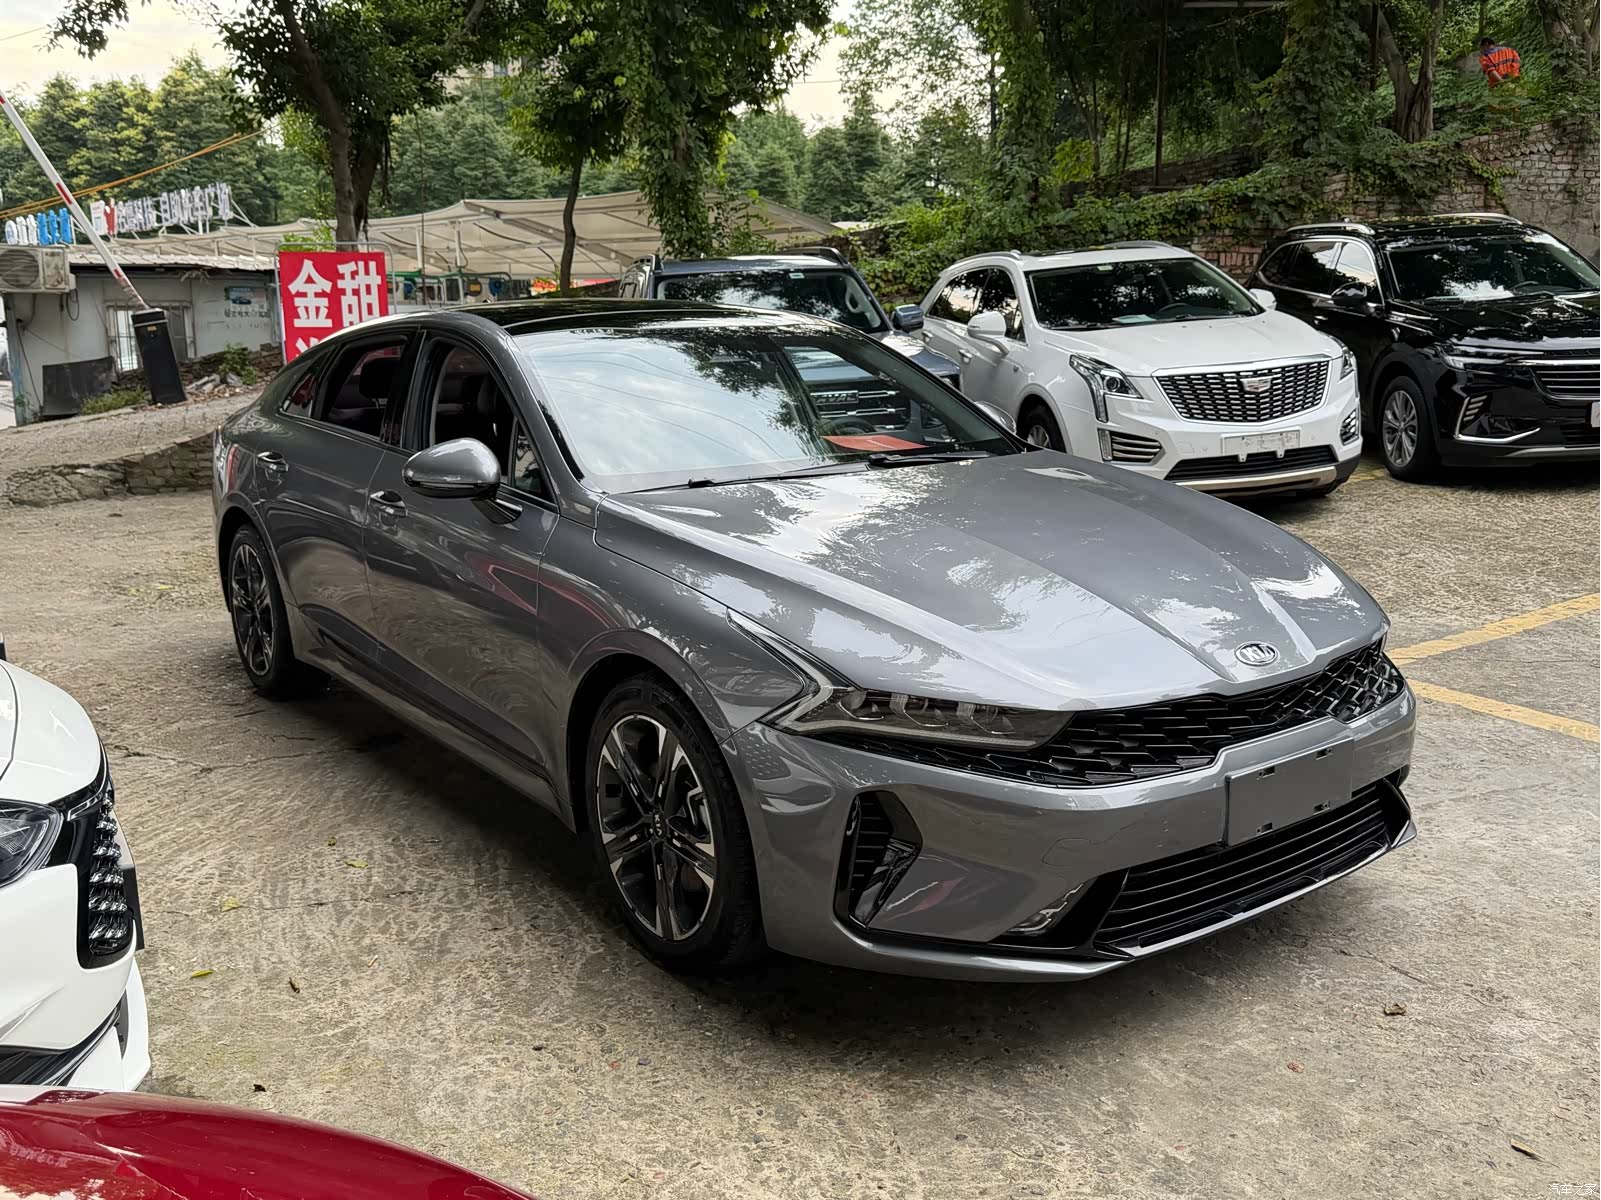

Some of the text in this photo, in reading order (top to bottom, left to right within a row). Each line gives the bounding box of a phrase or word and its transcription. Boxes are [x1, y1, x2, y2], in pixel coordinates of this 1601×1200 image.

[288, 259, 382, 328] 金甜
[815, 393, 856, 403] AVAL
[1240, 645, 1275, 662] KIA
